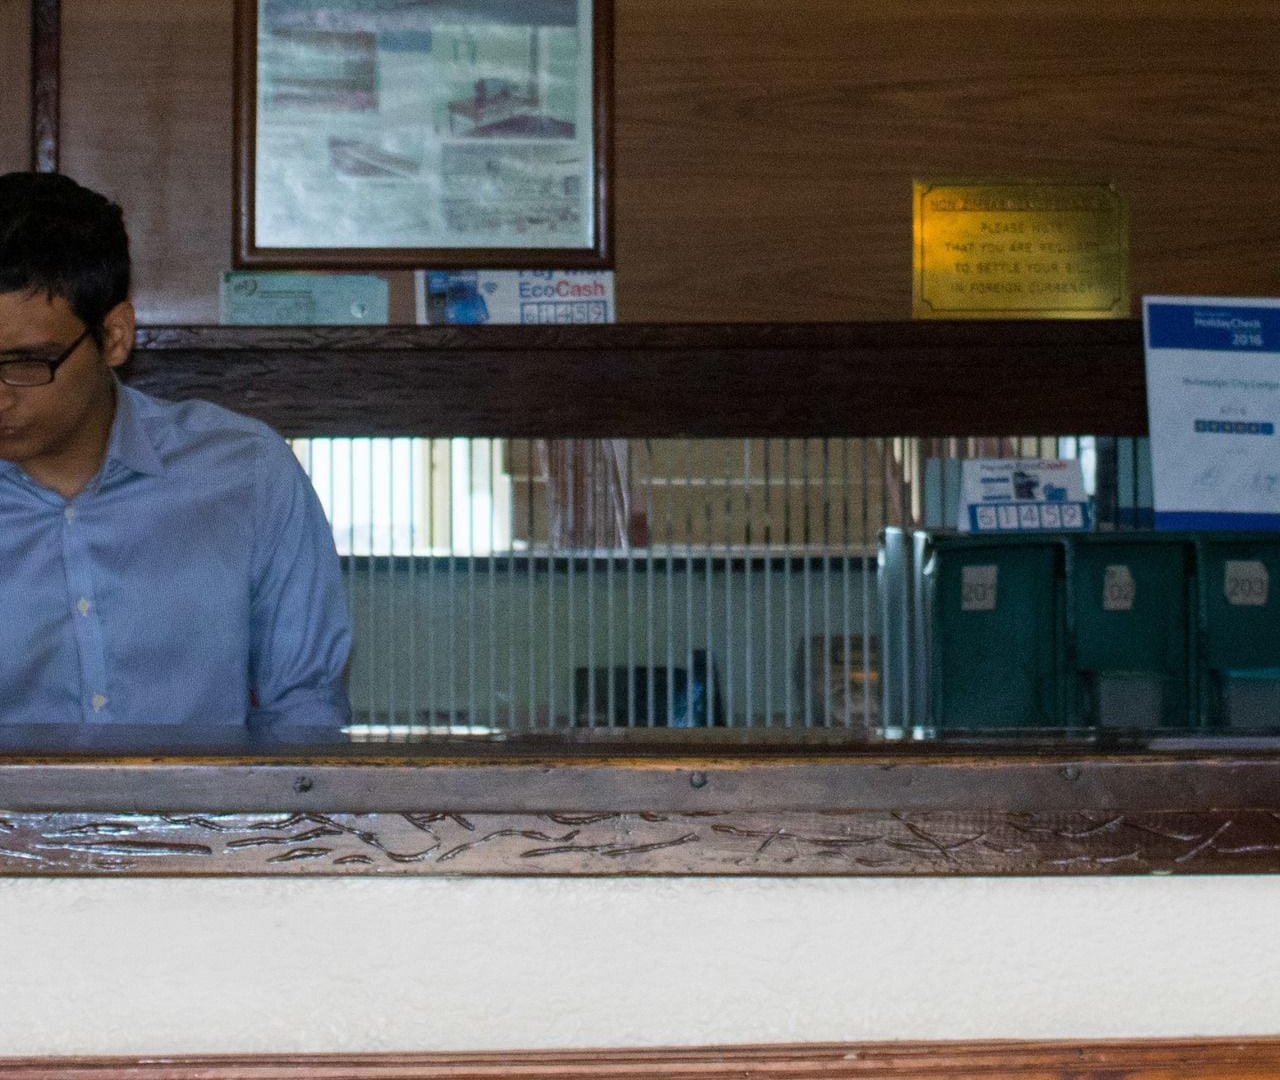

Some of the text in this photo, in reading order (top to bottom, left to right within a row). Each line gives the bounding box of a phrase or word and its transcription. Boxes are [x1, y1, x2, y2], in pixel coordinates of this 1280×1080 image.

[945, 242, 975, 253] THAT
[1010, 242, 1033, 254] ARE
[954, 262, 971, 274] TO
[519, 280, 605, 297] EcoCash
[1232, 333, 1263, 346] 2016
